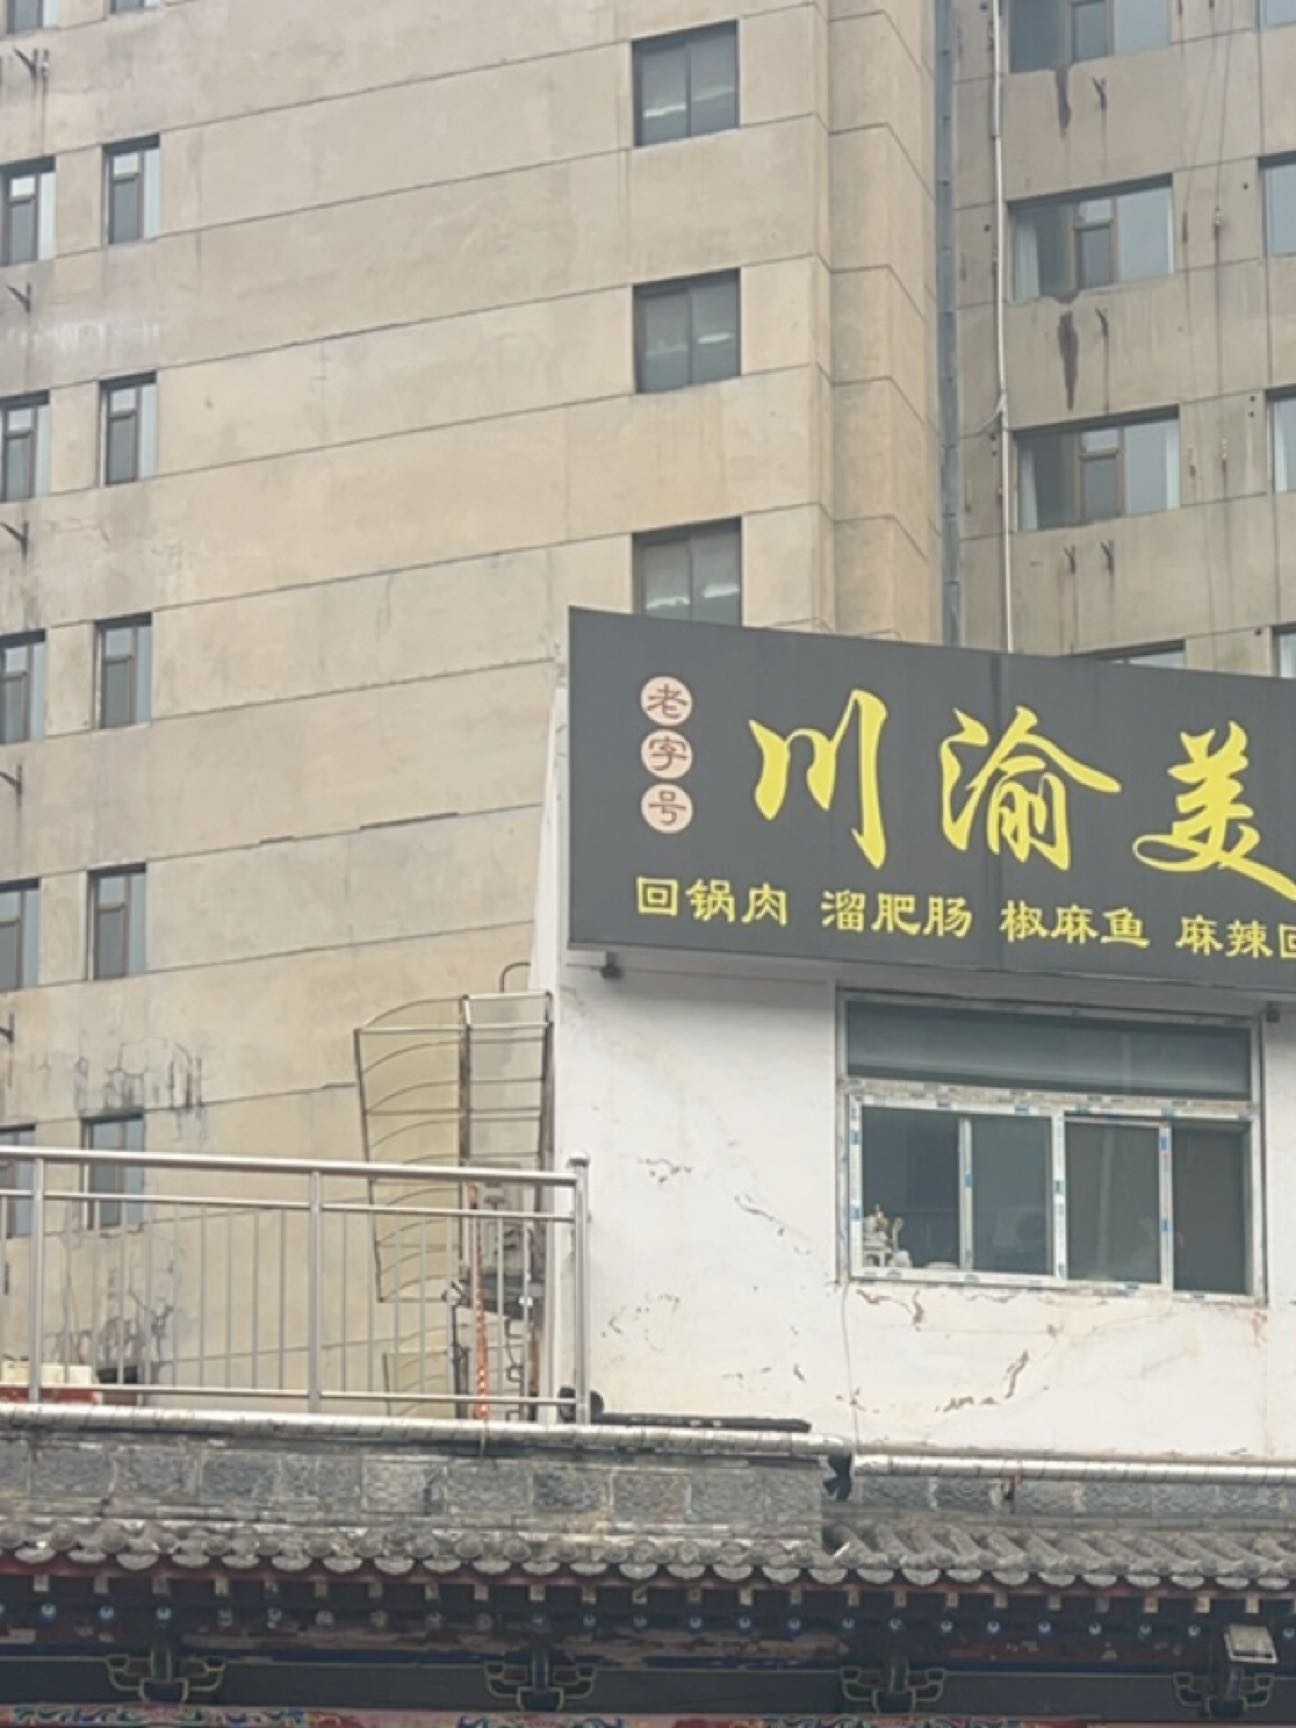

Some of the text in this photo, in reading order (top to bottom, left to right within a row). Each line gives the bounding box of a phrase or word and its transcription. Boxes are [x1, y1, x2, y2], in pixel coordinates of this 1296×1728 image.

[645, 682, 690, 827] 老字号
[635, 876, 790, 926] 回锅肉
[820, 891, 974, 938] 溜肥肠
[1000, 901, 1150, 950] 椒麻鱼
